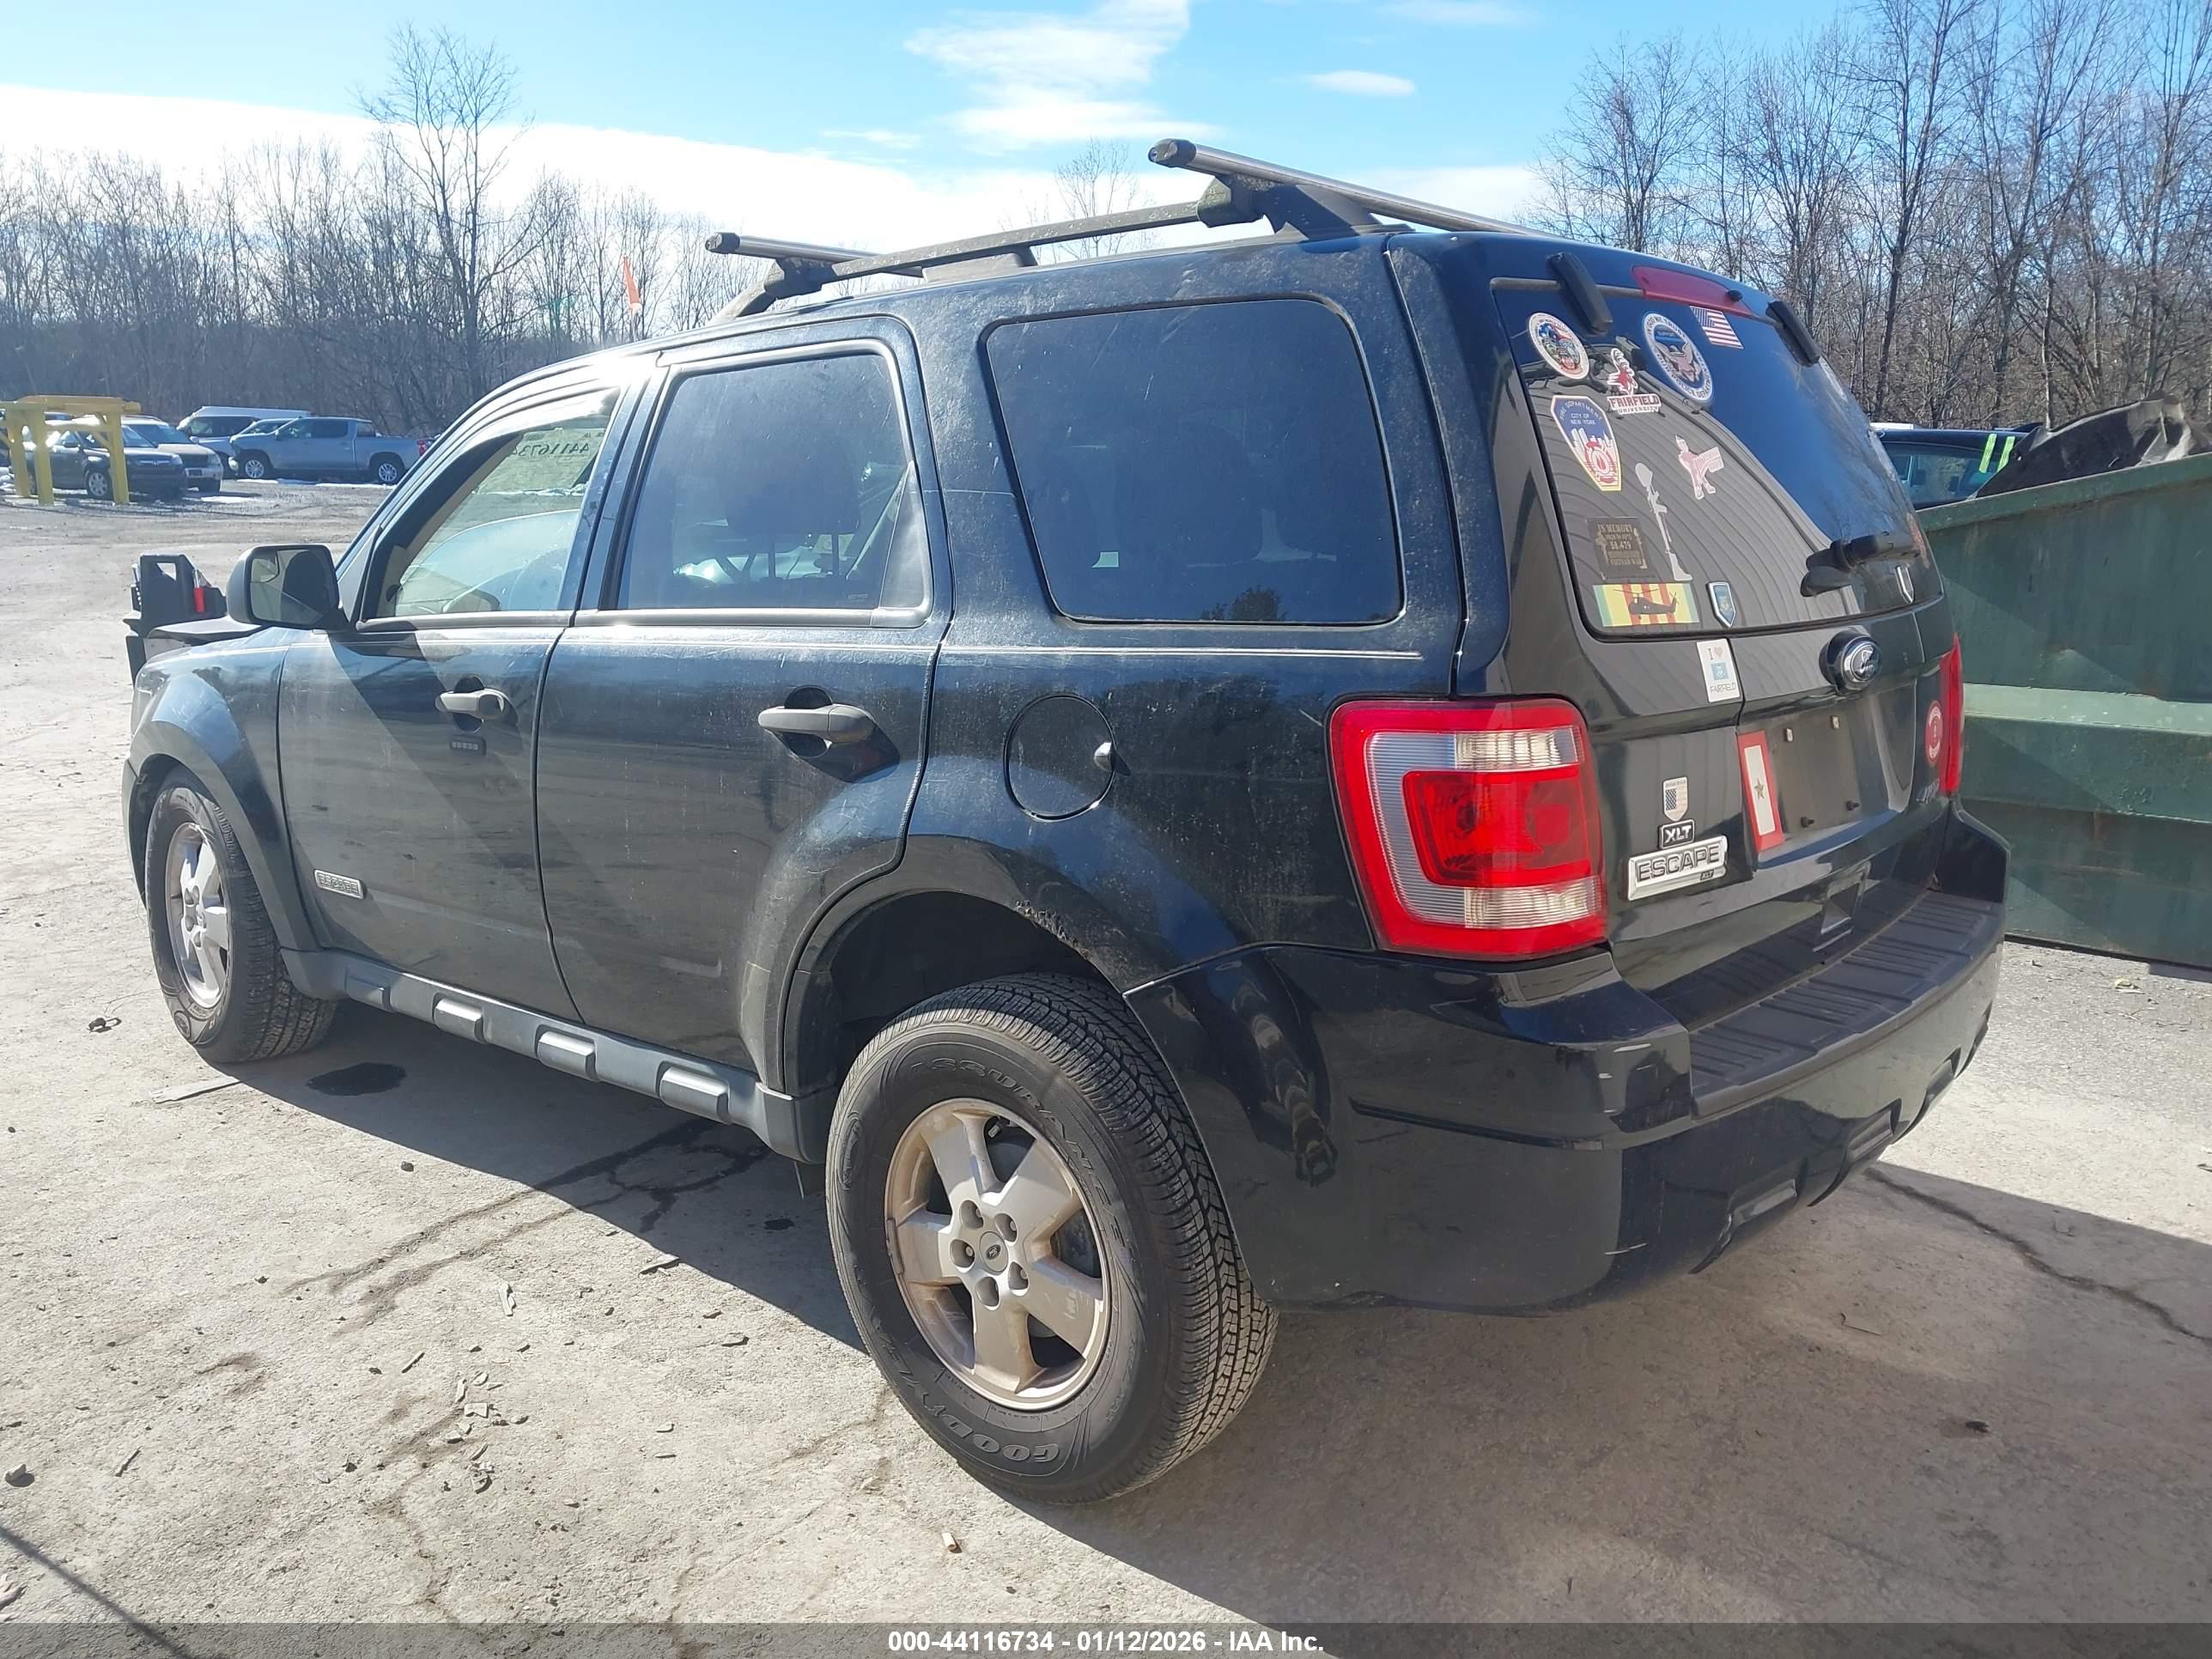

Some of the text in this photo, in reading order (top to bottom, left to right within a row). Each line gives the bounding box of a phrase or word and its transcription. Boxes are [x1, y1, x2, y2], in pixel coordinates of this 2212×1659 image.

[1610, 396, 1660, 407] FAIRFIELD
[1707, 647, 1714, 660] I
[1664, 824, 1692, 843] XLT
[1637, 843, 1720, 882] ESCAPE
[1701, 870, 1714, 880] XLT
